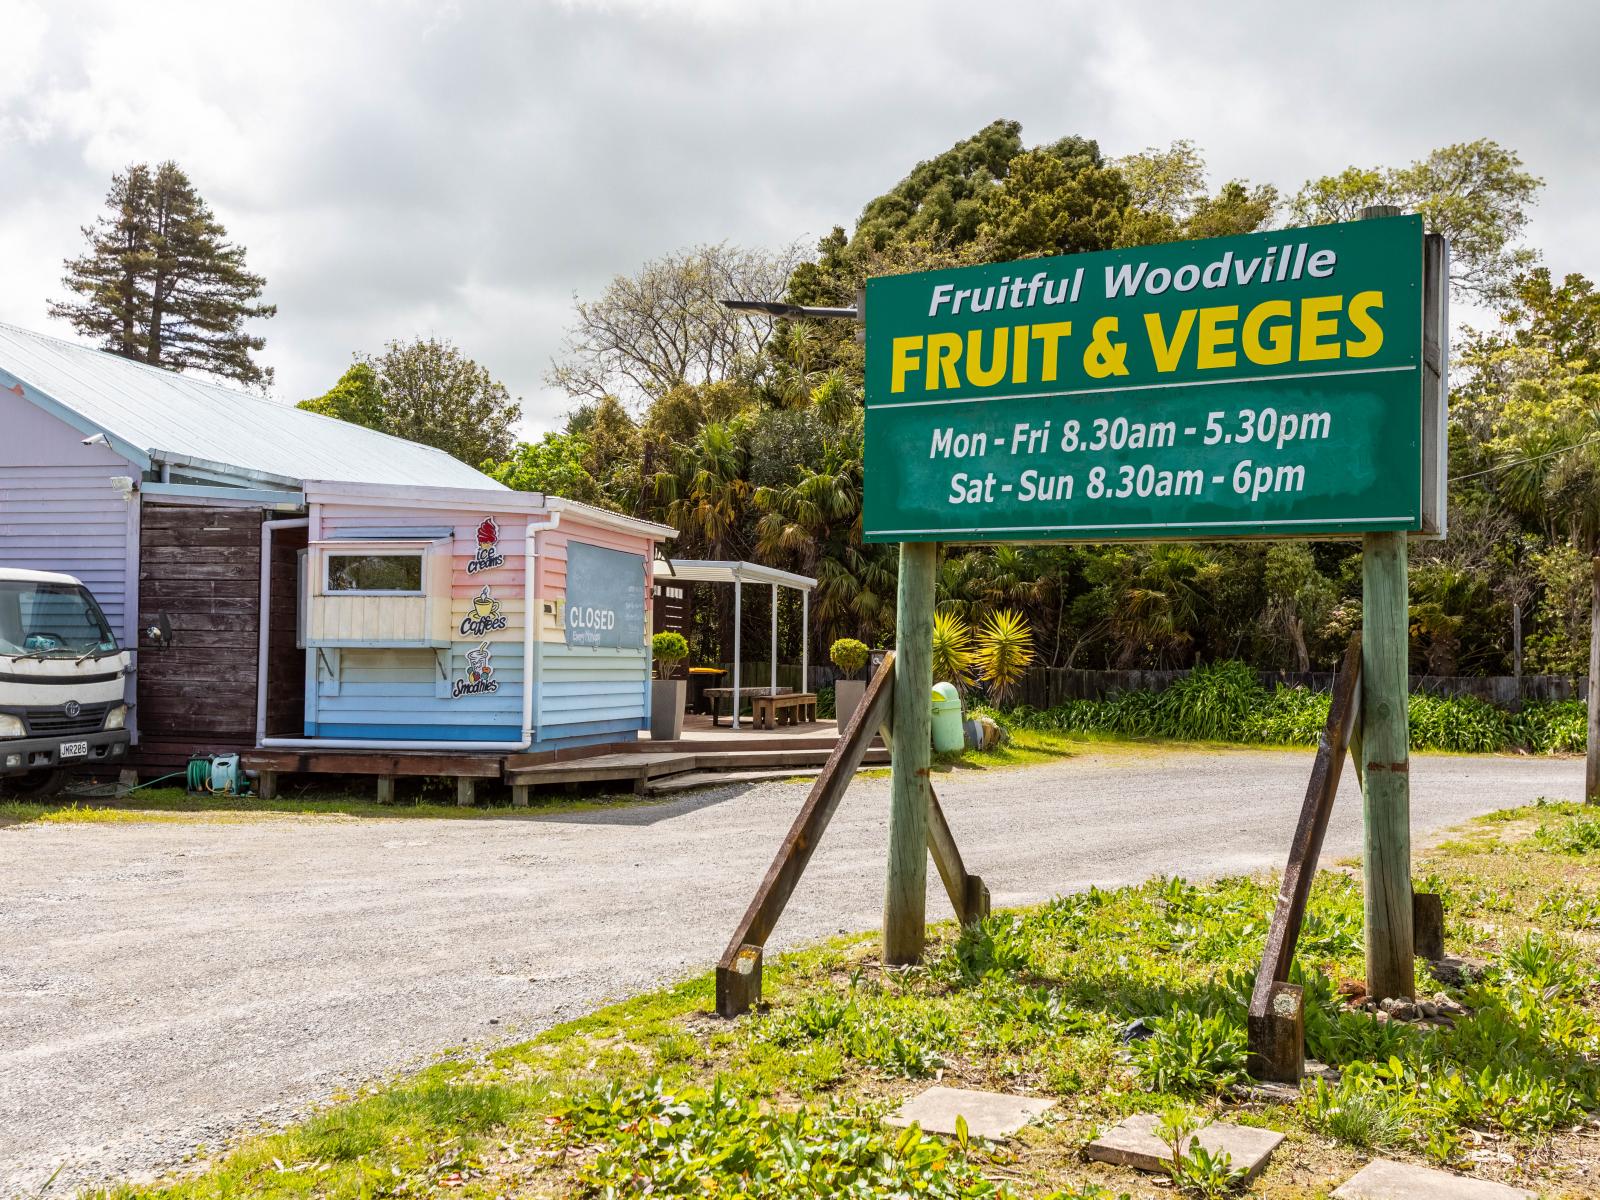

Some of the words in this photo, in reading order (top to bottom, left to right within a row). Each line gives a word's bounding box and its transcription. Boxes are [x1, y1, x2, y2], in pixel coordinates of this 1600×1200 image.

[929, 268, 1085, 317] Fruitful
[1105, 243, 1337, 299] Woodville
[891, 322, 1072, 393] FRUIT
[1083, 317, 1129, 378] &
[1143, 291, 1384, 373] VEGES
[930, 428, 986, 458] Mon
[1011, 420, 1051, 455] Fri
[1061, 417, 1176, 453] 8.30am
[1203, 408, 1332, 450] 5.30pm
[949, 472, 997, 504] Sat
[1018, 470, 1074, 502] Sun
[1086, 464, 1204, 499] 8.30am
[1232, 459, 1306, 501] 6pm
[467, 555, 503, 573] creams
[477, 547, 495, 560] ice
[460, 616, 506, 635] Coffees
[570, 606, 615, 630] CLOSED
